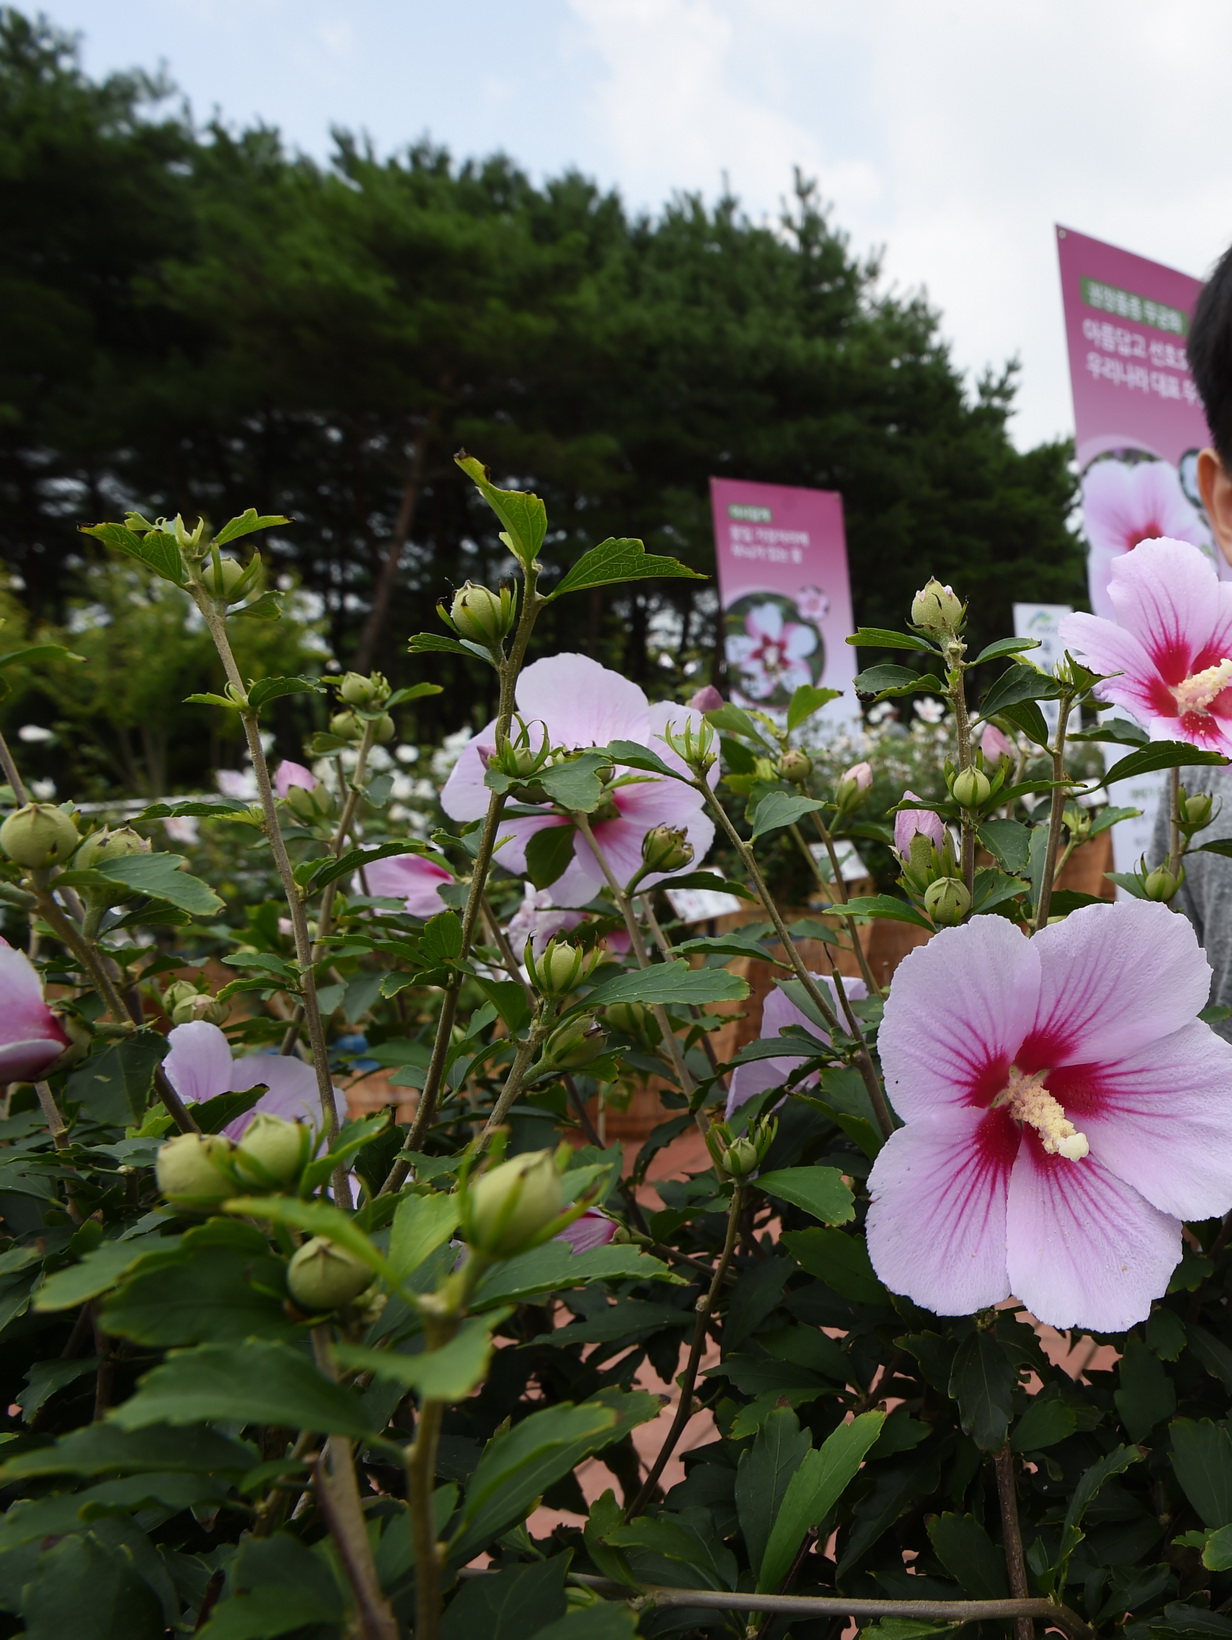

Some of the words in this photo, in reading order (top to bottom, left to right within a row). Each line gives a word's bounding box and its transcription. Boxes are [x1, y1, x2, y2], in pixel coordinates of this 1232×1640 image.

[1143, 300, 1183, 334] 무궁화
[1082, 318, 1147, 359] 아름답고
[1086, 352, 1149, 393] 우리나라
[1150, 371, 1182, 400] 대표
